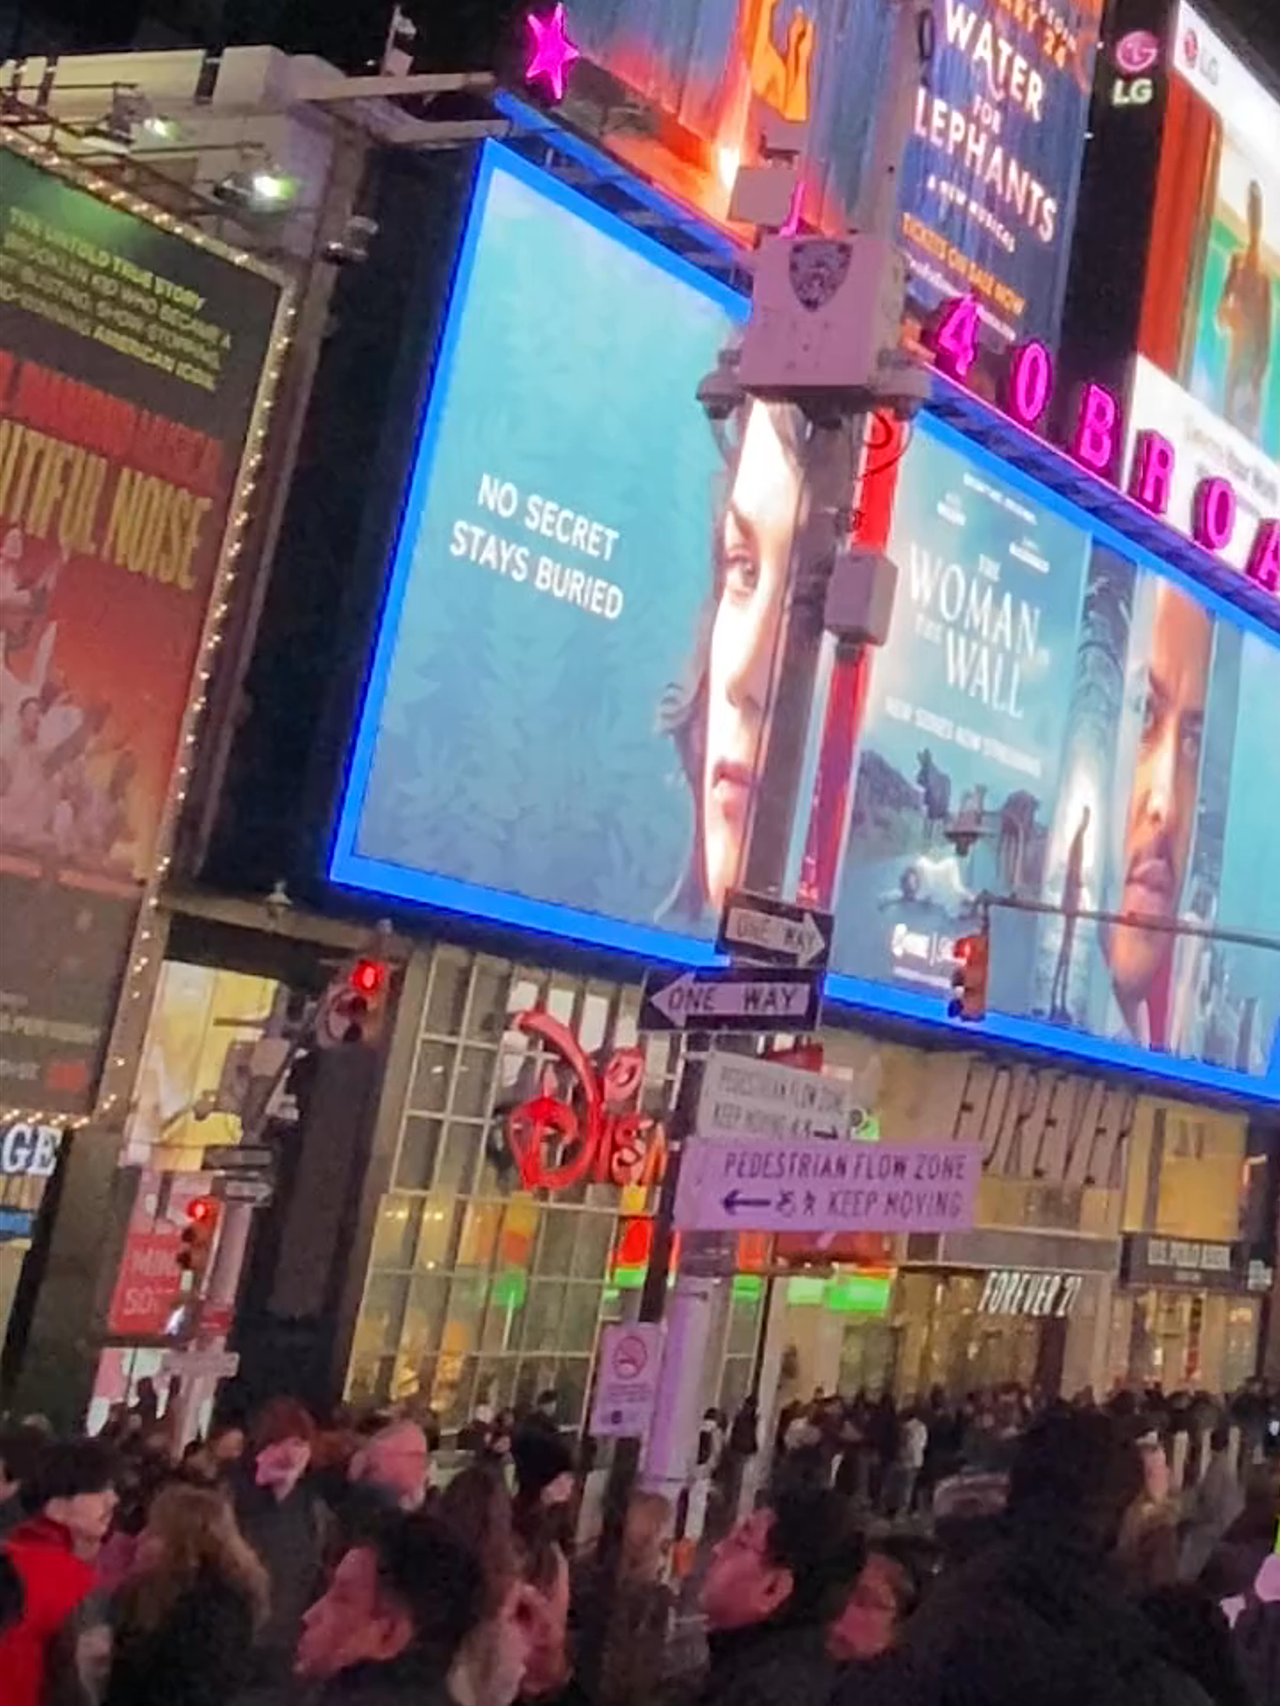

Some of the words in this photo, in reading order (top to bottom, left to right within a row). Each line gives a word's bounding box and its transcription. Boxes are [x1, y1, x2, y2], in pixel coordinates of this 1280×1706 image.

[973, 94, 1002, 135] FOR
[1112, 78, 1153, 107] LG
[913, 85, 1058, 243] LEPHANTS
[101, 465, 214, 590] NOISE
[477, 472, 518, 518] NO
[525, 494, 620, 561] SECRET
[449, 520, 530, 582] STAYS
[534, 555, 624, 620] BURIED
[909, 540, 1041, 660] WOMAN
[946, 627, 1025, 720] WALL
[668, 985, 718, 1011] ONE
[744, 986, 798, 1012] WAY
[724, 1151, 848, 1179] PEDESTRIAN
[852, 1152, 909, 1179] FLOW
[913, 1153, 968, 1180] ZONE
[826, 1189, 879, 1218] KEEP
[886, 1191, 965, 1219] MOVING
[978, 1270, 1061, 1317] FOREVER
